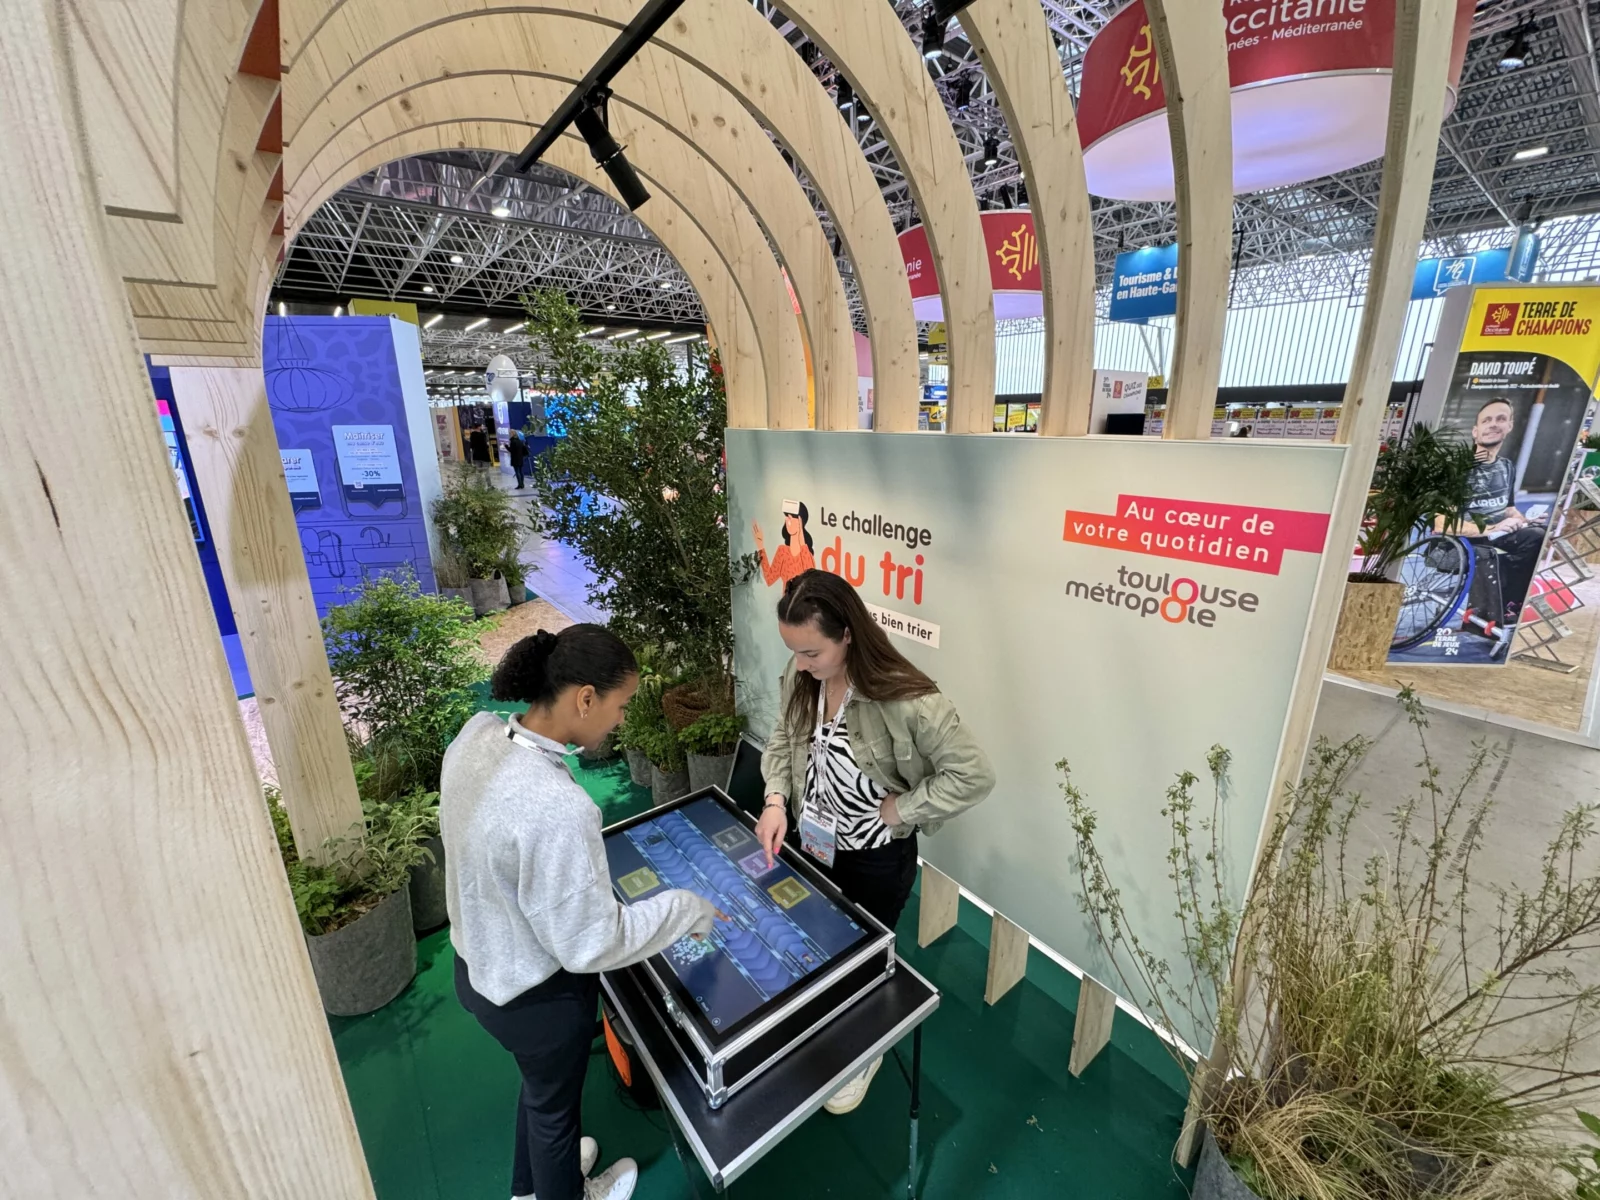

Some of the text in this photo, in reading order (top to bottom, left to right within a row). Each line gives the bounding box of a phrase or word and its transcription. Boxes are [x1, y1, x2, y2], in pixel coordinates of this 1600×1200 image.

[1224, 0, 1367, 35] ccitanie
[1271, 18, 1363, 41] Méditerranée
[1119, 271, 1163, 287] Tourisme
[1163, 267, 1172, 280] &
[1116, 290, 1129, 300] en
[1521, 301, 1578, 319] TERRE DE
[1516, 318, 1593, 336] CHAMPIONS
[1470, 357, 1538, 376] DAVID TOUPÉ
[820, 506, 932, 549] Le challenge
[1124, 501, 1275, 536] Au cœur de
[1073, 521, 1269, 563] votre quotidien
[821, 536, 925, 605] du tri
[1065, 580, 1217, 628] métropole
[1117, 565, 1259, 613] toulouse
[881, 610, 904, 631] bien
[907, 621, 933, 641] trier
